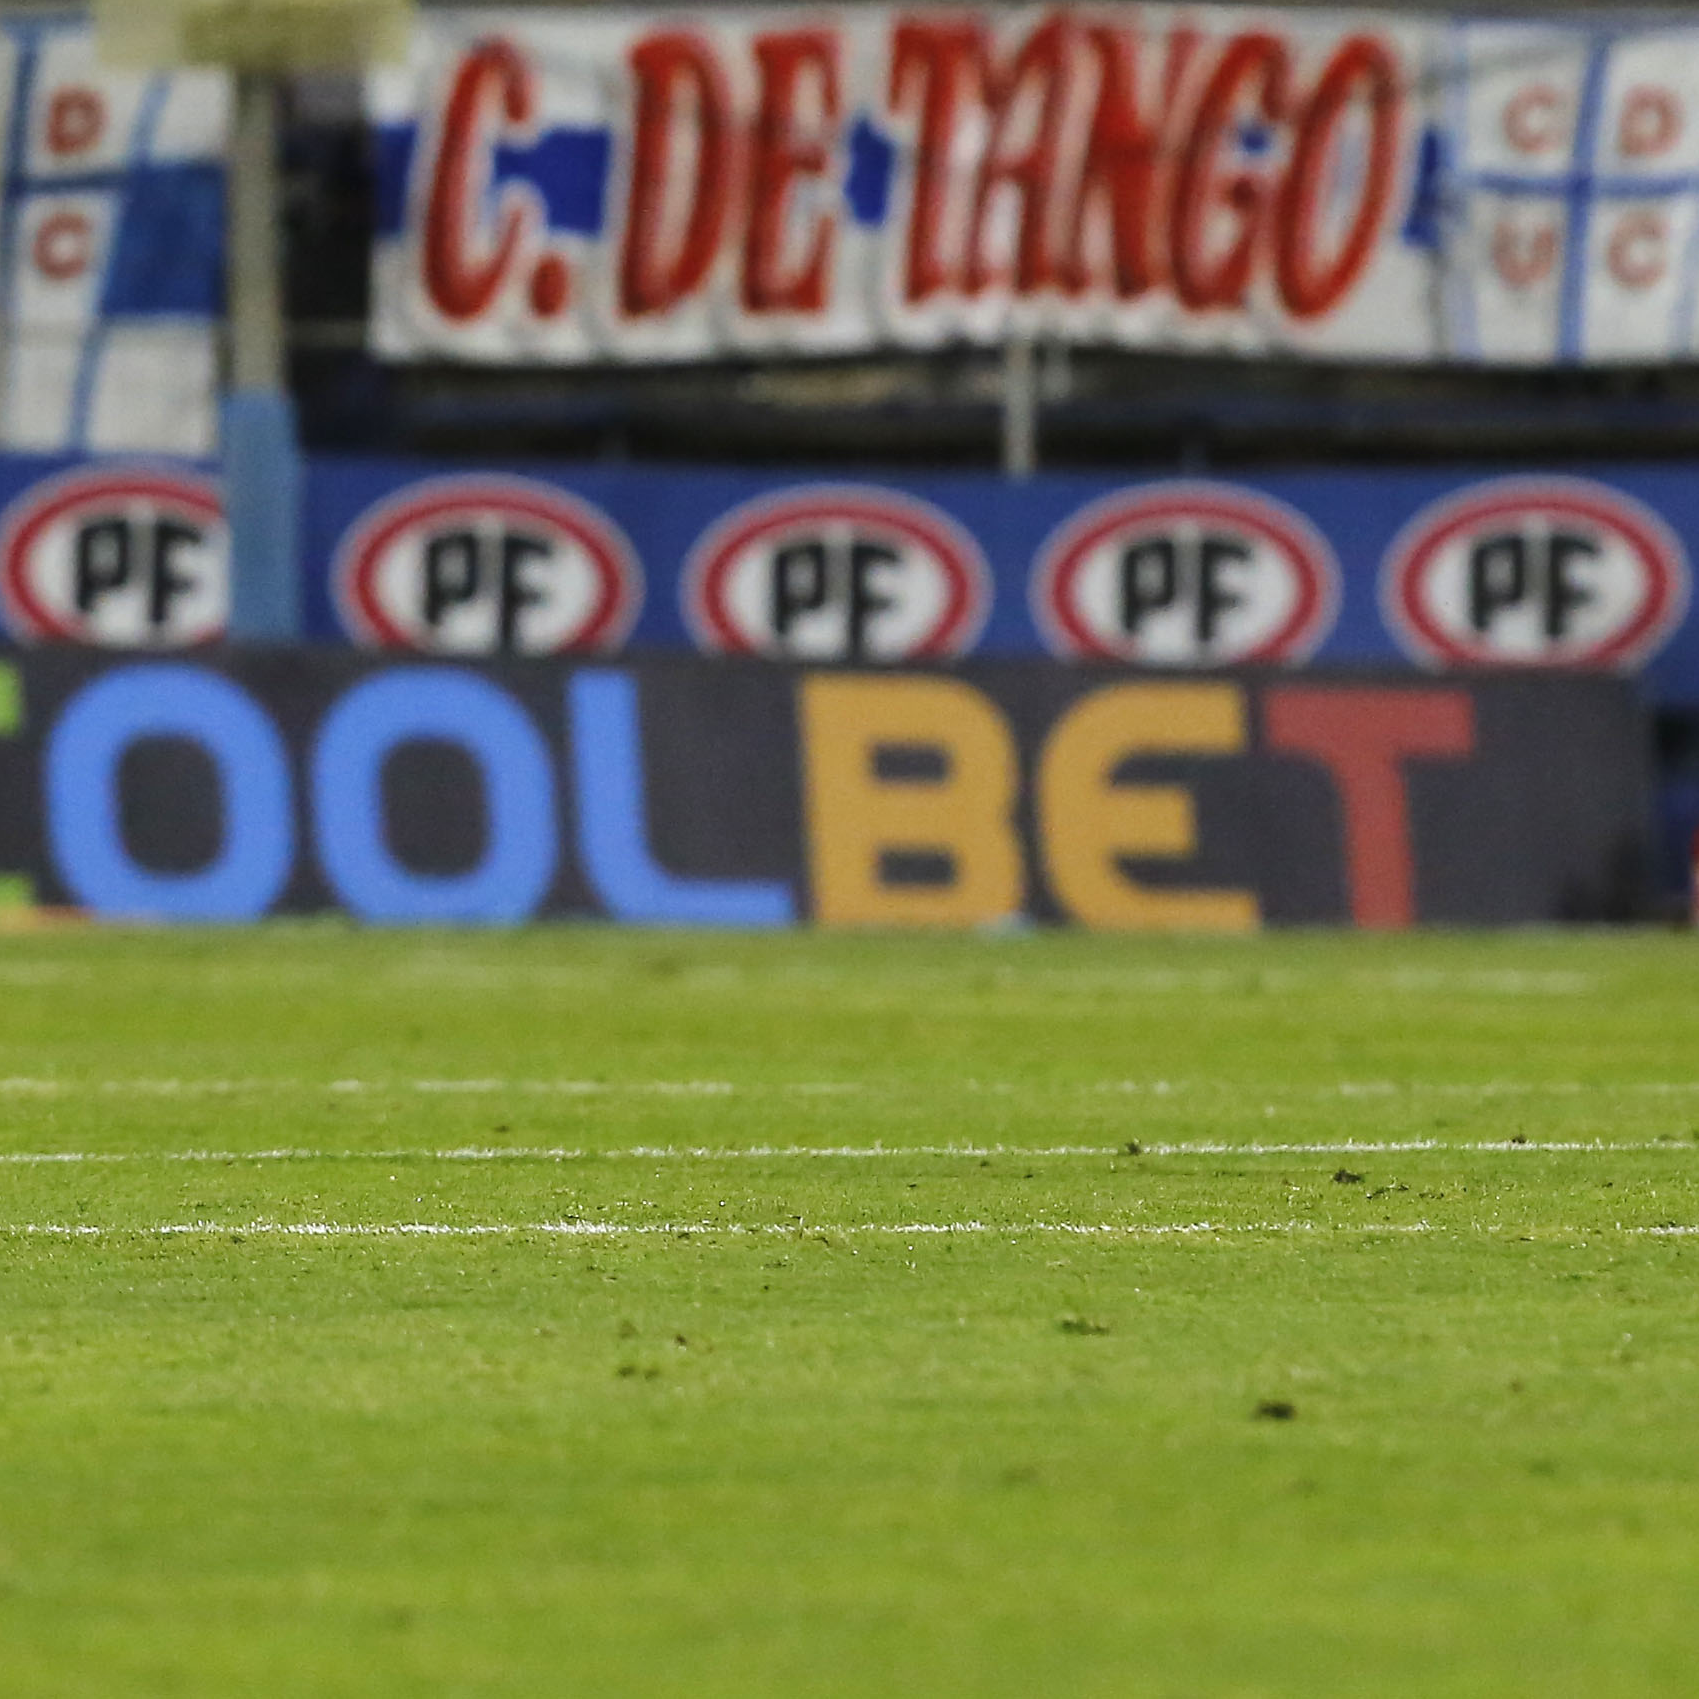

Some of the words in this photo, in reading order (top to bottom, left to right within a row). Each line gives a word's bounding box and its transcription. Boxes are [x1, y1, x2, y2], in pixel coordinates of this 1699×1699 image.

[616, 24, 844, 320] DE
[886, 8, 1400, 322] TANGO
[73, 516, 202, 624] PF
[421, 530, 552, 638] PF
[768, 539, 902, 647] PF
[1117, 537, 1252, 646] PF
[1466, 532, 1600, 639] PF
